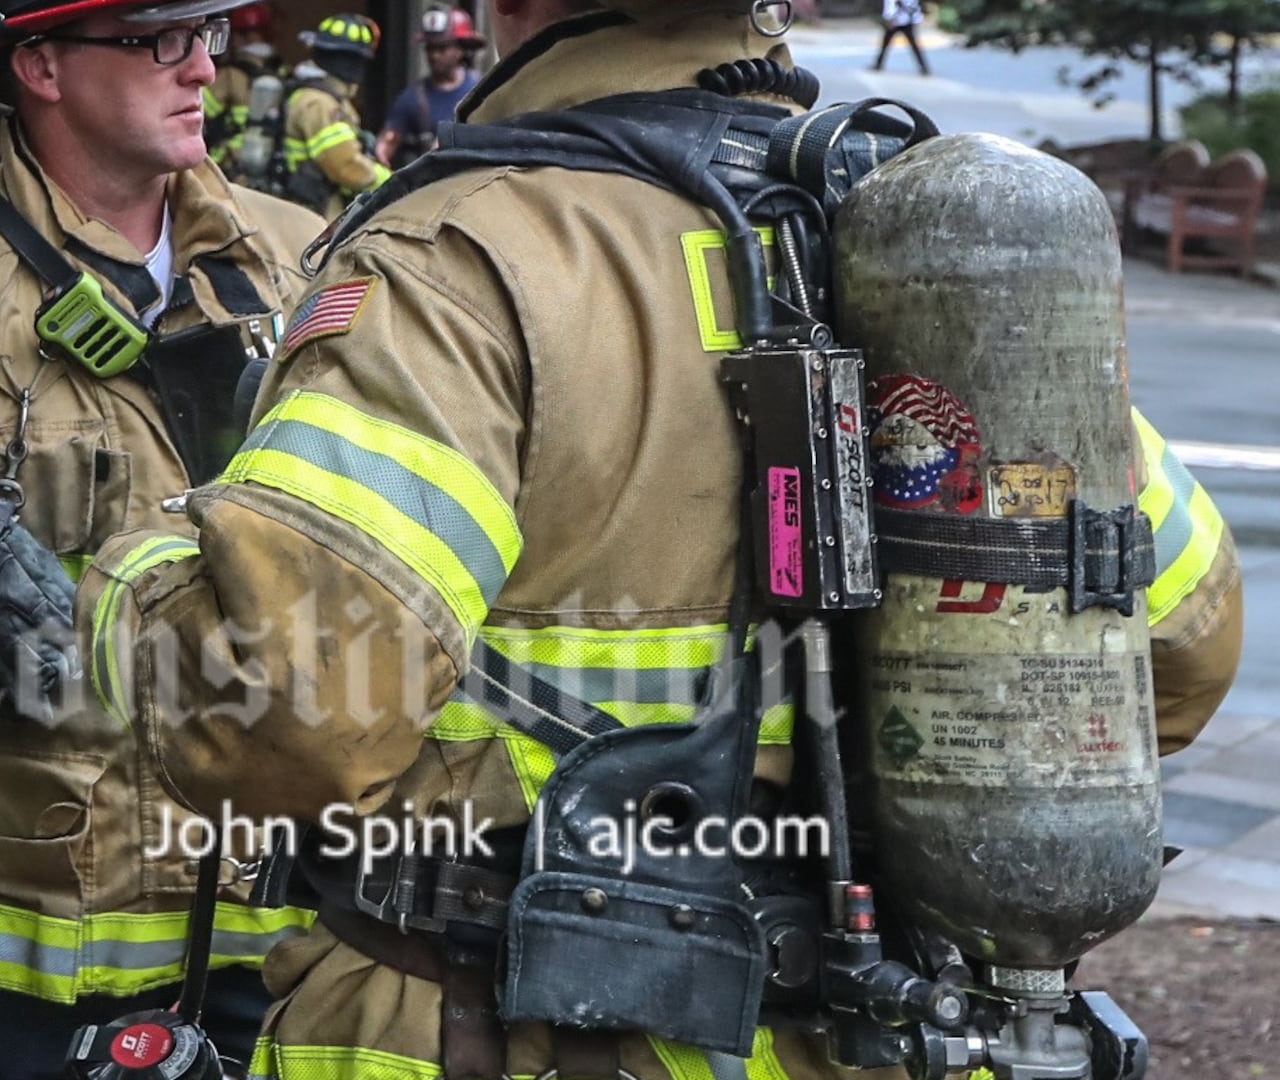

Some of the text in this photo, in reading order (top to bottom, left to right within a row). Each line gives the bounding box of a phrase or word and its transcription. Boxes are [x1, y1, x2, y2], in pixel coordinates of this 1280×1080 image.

[845, 438, 864, 513] SCOTT
[784, 474, 799, 528] MES
[932, 724, 977, 735] UN 1002
[949, 737, 1006, 749] MINUTES
[134, 1031, 150, 1059] SCOTT
